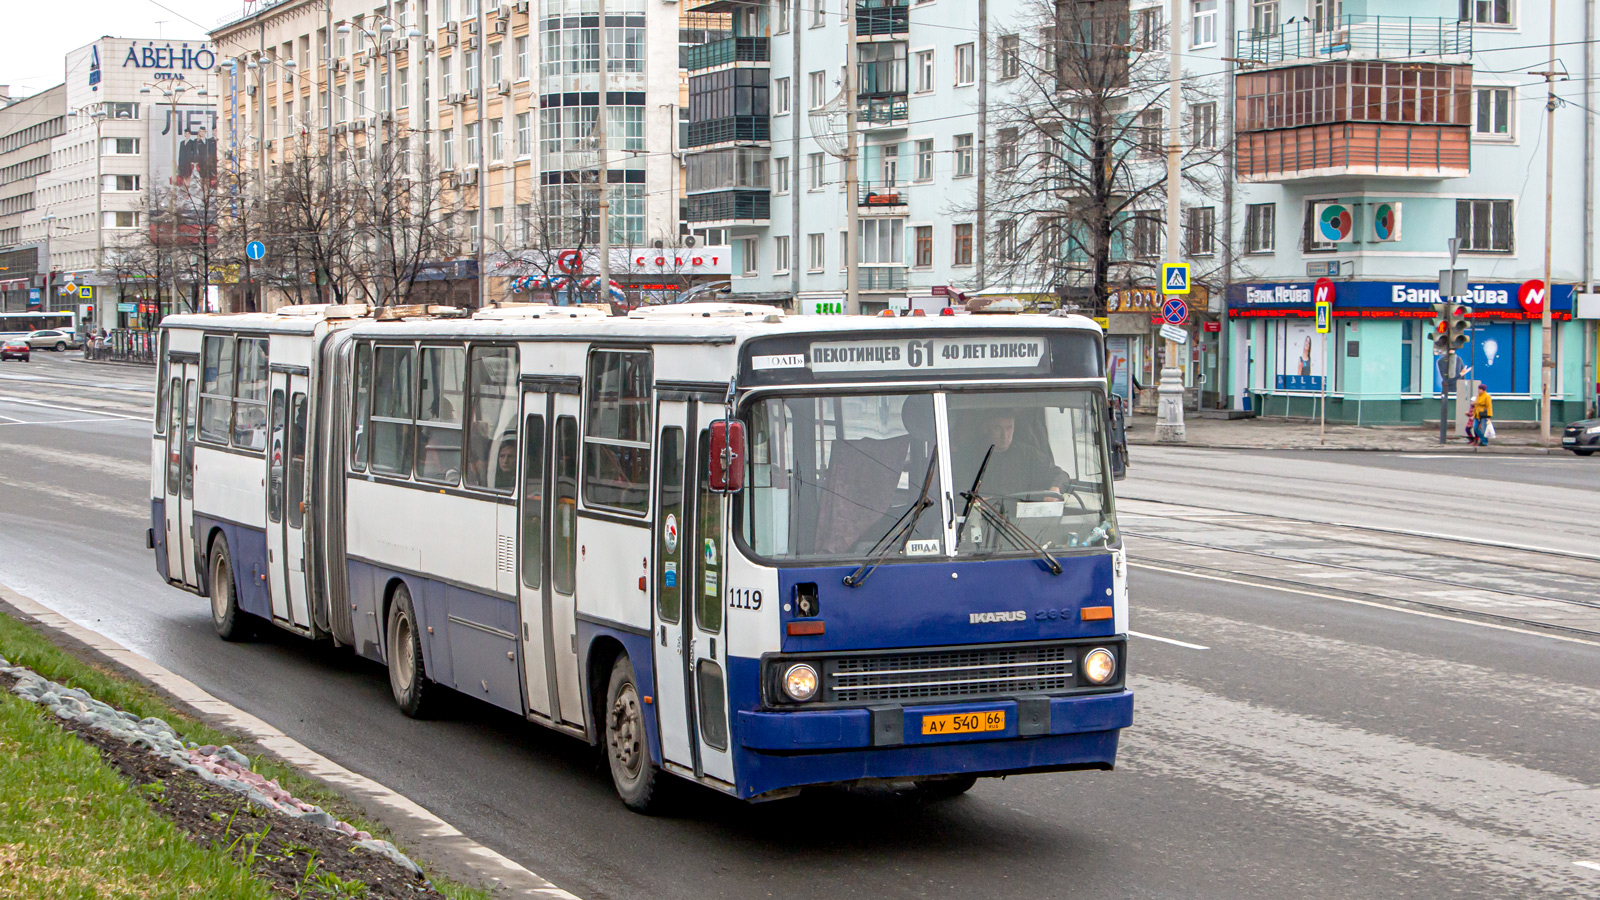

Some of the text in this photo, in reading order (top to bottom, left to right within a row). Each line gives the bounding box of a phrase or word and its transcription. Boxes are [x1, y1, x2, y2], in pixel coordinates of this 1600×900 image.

[122, 47, 215, 70] АВЕНЮ
[154, 72, 185, 80] ОТЕЛЬ
[1246, 286, 1275, 303] Банк
[1275, 285, 1312, 303] Нейва
[1391, 285, 1443, 303] Банк
[815, 302, 842, 315] SELA
[813, 340, 1039, 367] ПЕХОТИНЦЕВ 61 40 ЛЕТ ВЛКСМ
[729, 587, 762, 611] 1119
[969, 610, 1027, 624] IKARUS
[953, 715, 979, 731] 540
[987, 712, 1001, 725] 66
